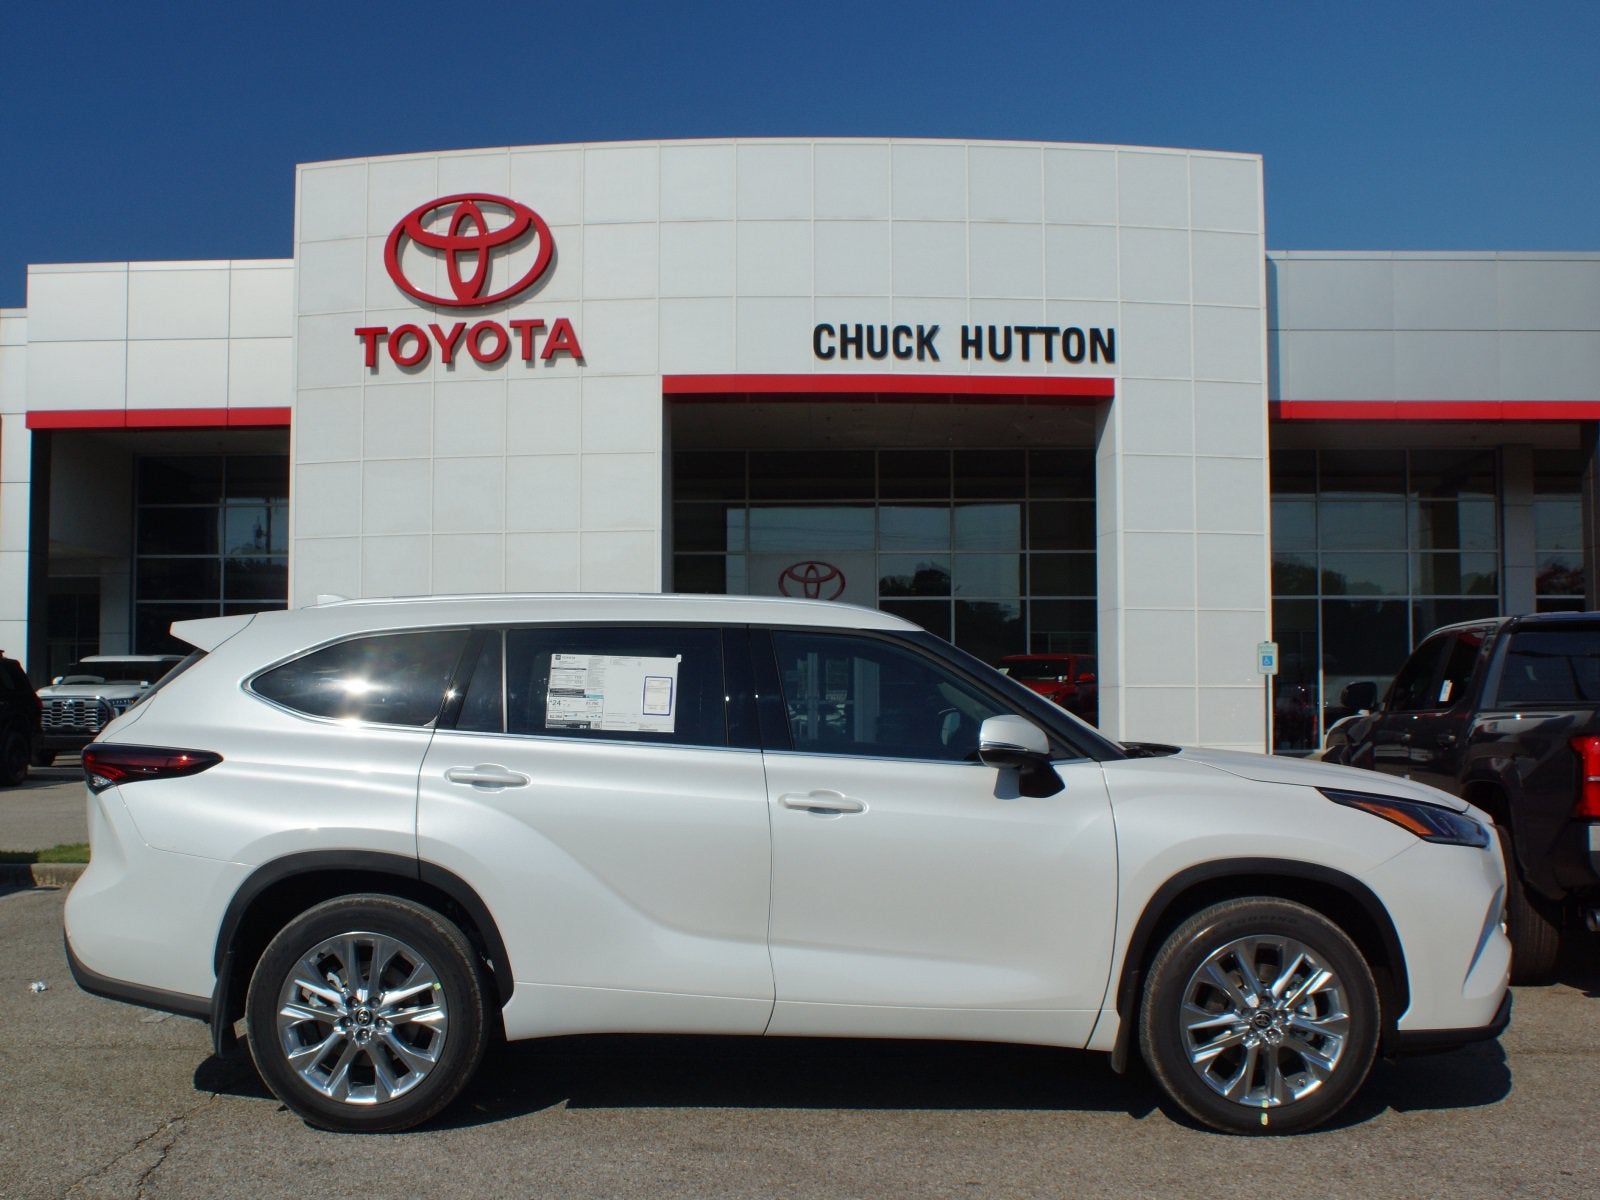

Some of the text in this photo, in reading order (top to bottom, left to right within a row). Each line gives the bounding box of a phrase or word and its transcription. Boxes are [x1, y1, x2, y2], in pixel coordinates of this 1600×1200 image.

[354, 318, 584, 368] TOYOTA
[812, 323, 1117, 364] CHUCK HUTTON
